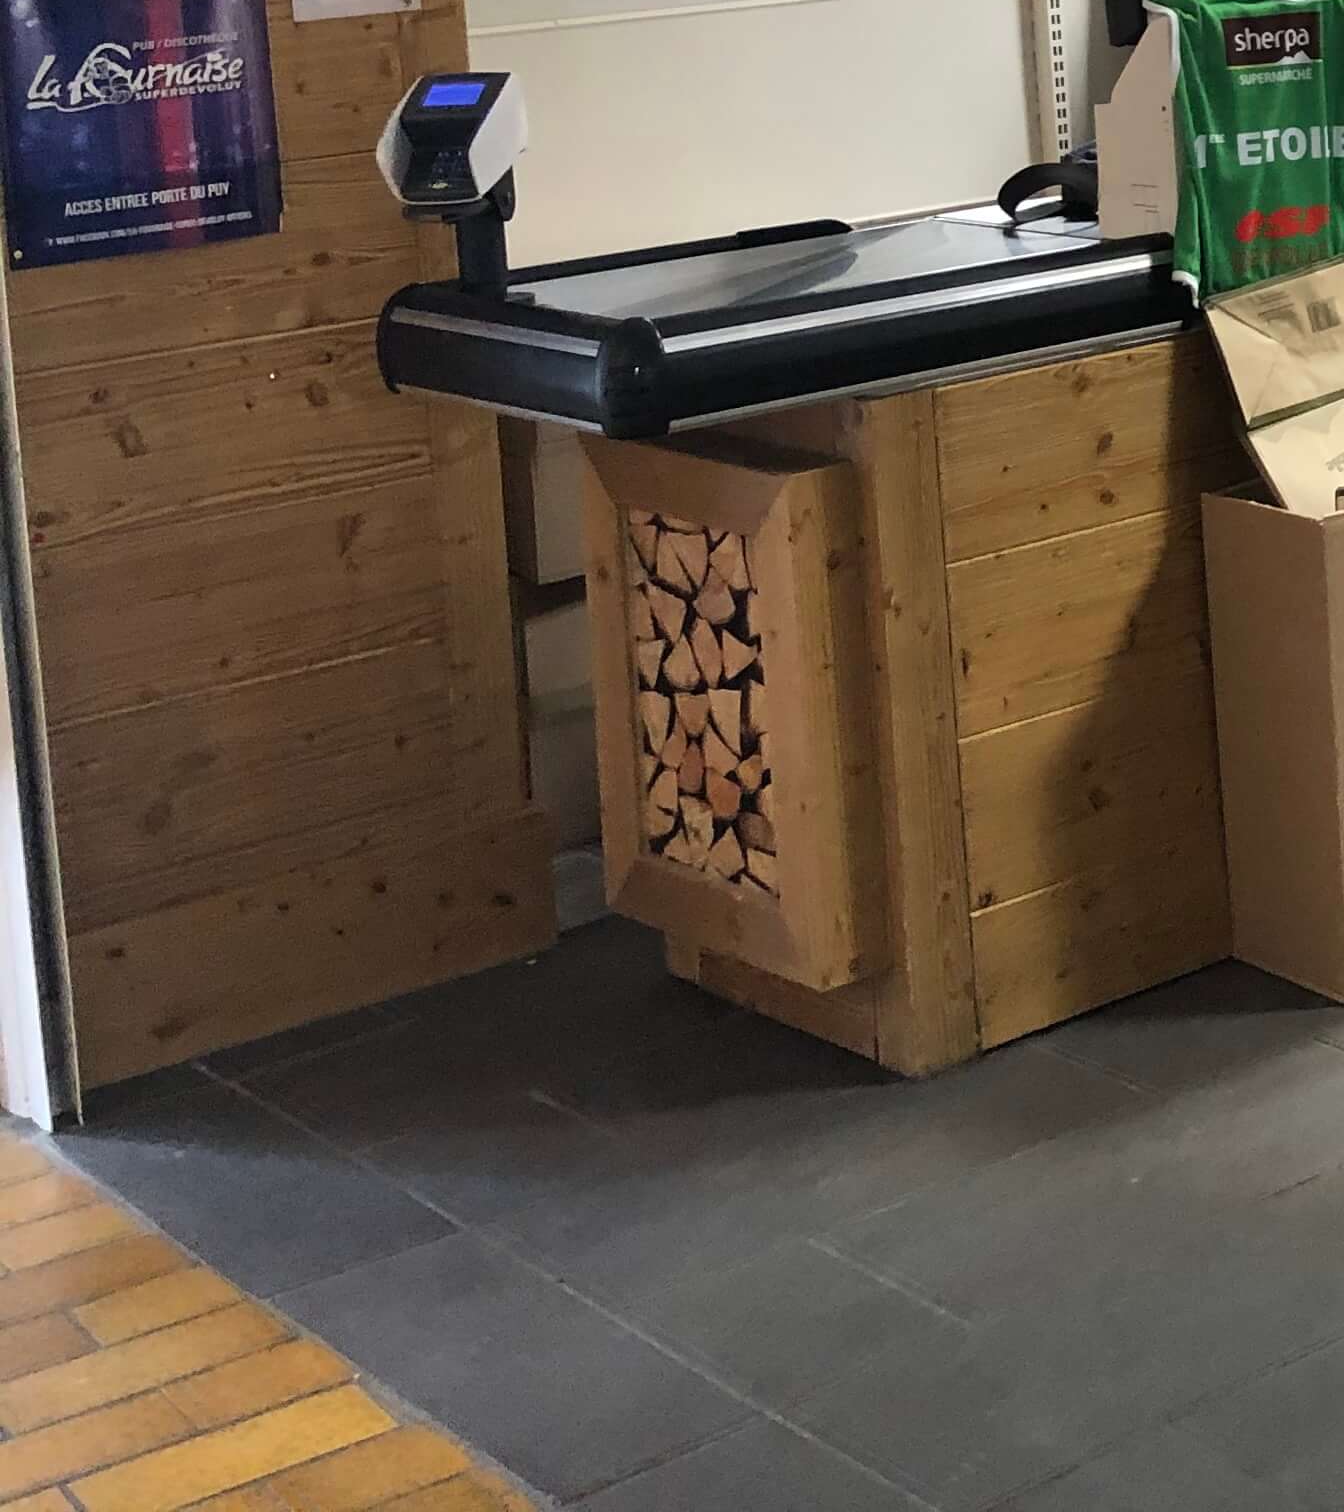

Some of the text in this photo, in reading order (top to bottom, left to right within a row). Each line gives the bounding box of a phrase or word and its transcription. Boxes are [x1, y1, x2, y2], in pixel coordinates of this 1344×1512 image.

[1234, 27, 1310, 53] sherpa
[64, 198, 104, 217] ACCES
[105, 192, 150, 213] ENTREE
[151, 187, 188, 206] PORTE
[190, 185, 207, 200] DU
